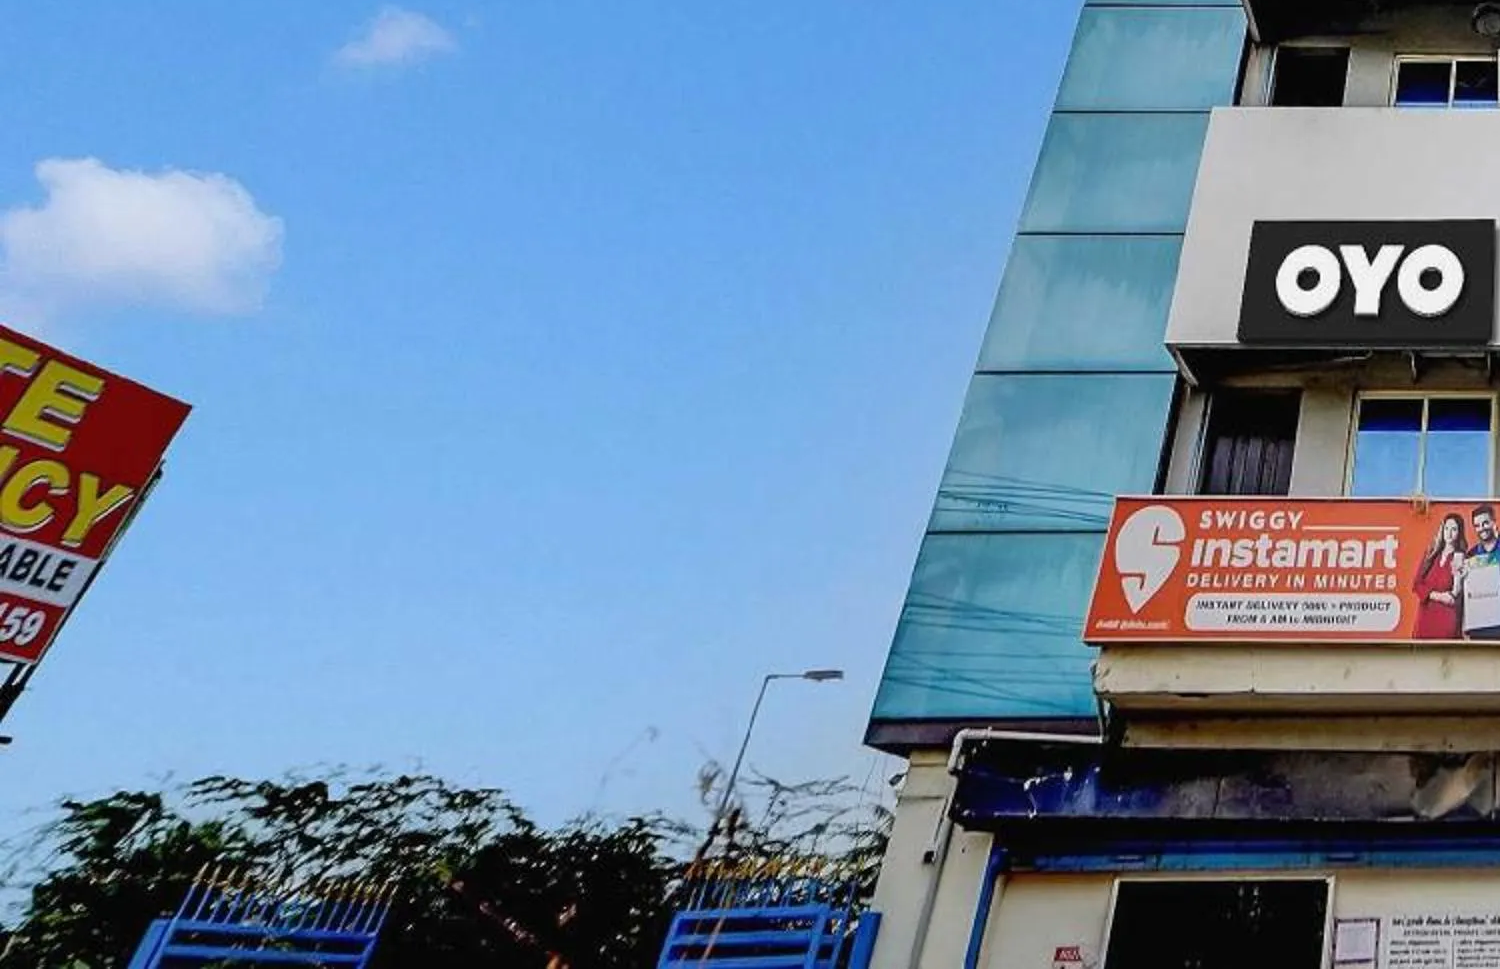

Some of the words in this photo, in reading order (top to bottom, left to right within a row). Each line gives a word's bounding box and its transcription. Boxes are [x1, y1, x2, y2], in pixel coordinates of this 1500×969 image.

[1275, 244, 1465, 318] OYO
[0, 445, 135, 548] CY
[1199, 510, 1304, 530] SWIGGY
[1190, 533, 1399, 569] instamart
[1187, 573, 1279, 588] DELIVERY
[1287, 573, 1305, 588] IN
[1314, 573, 1397, 589] MINUTES
[0, 601, 46, 646] 59
